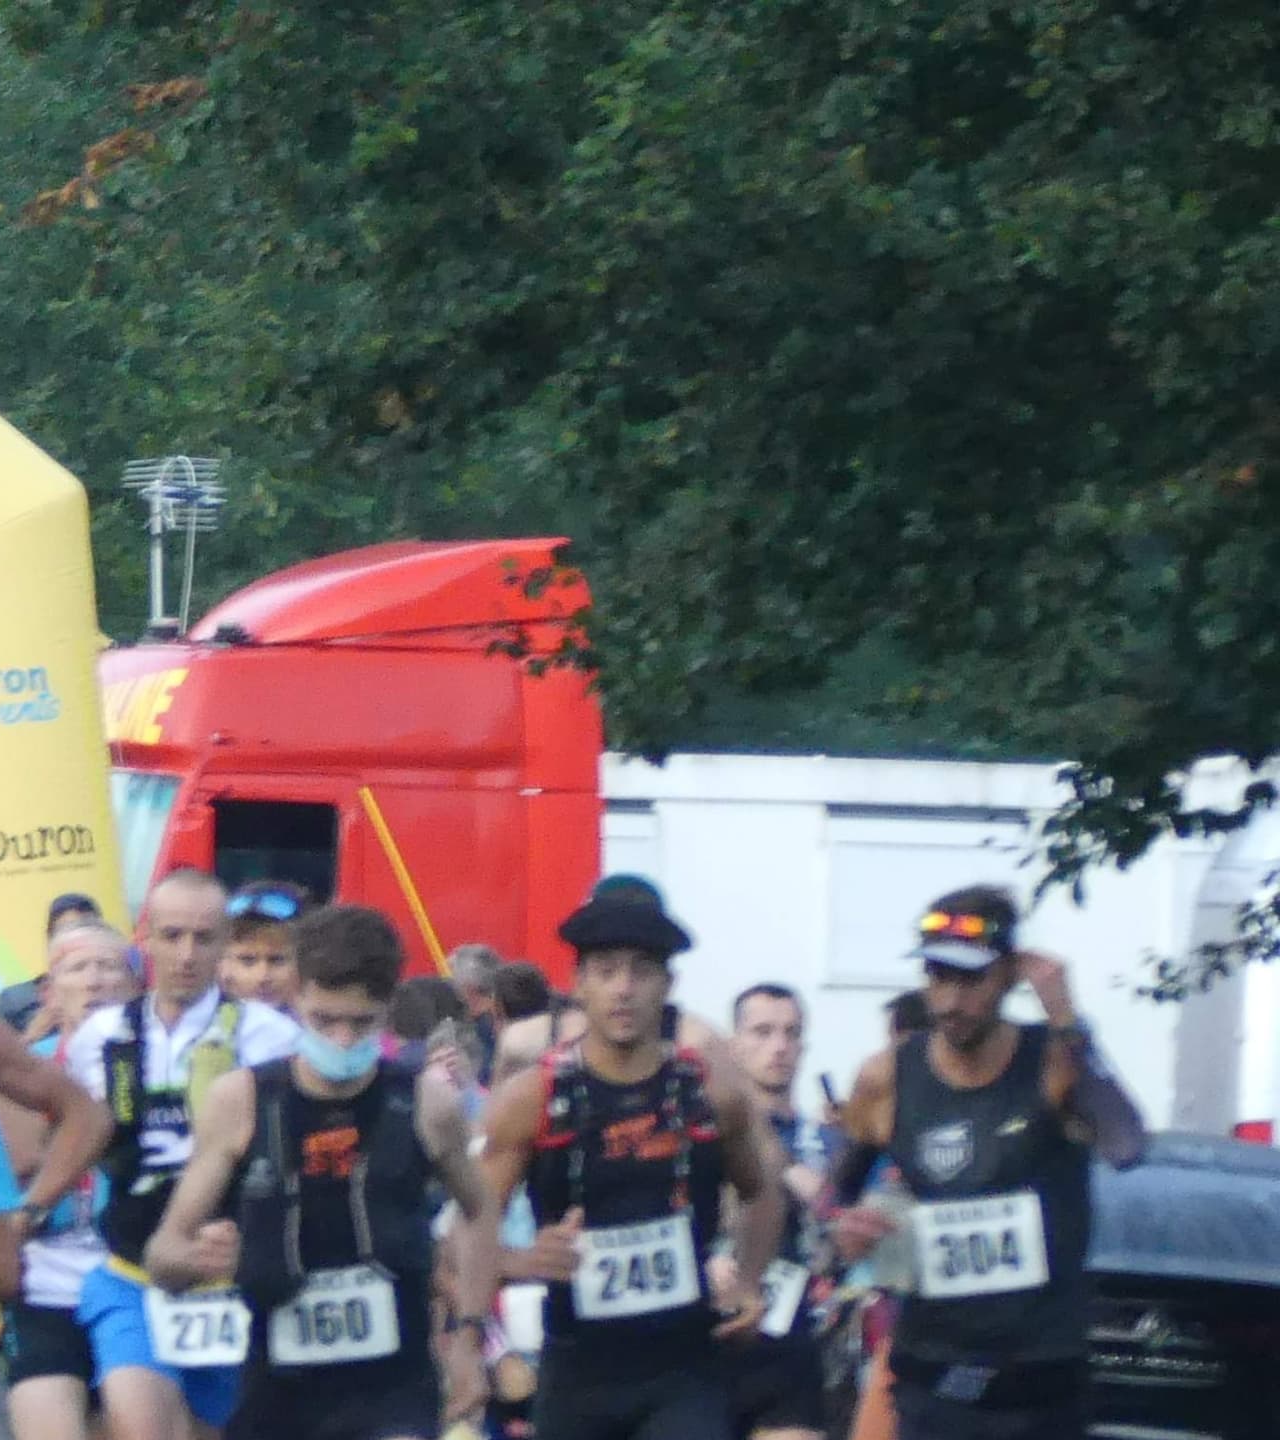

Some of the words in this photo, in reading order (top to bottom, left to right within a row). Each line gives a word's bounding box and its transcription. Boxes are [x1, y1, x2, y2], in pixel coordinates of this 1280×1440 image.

[597, 1249, 678, 1301] 249
[936, 1228, 1023, 1278] 304
[293, 1297, 372, 1346] 160
